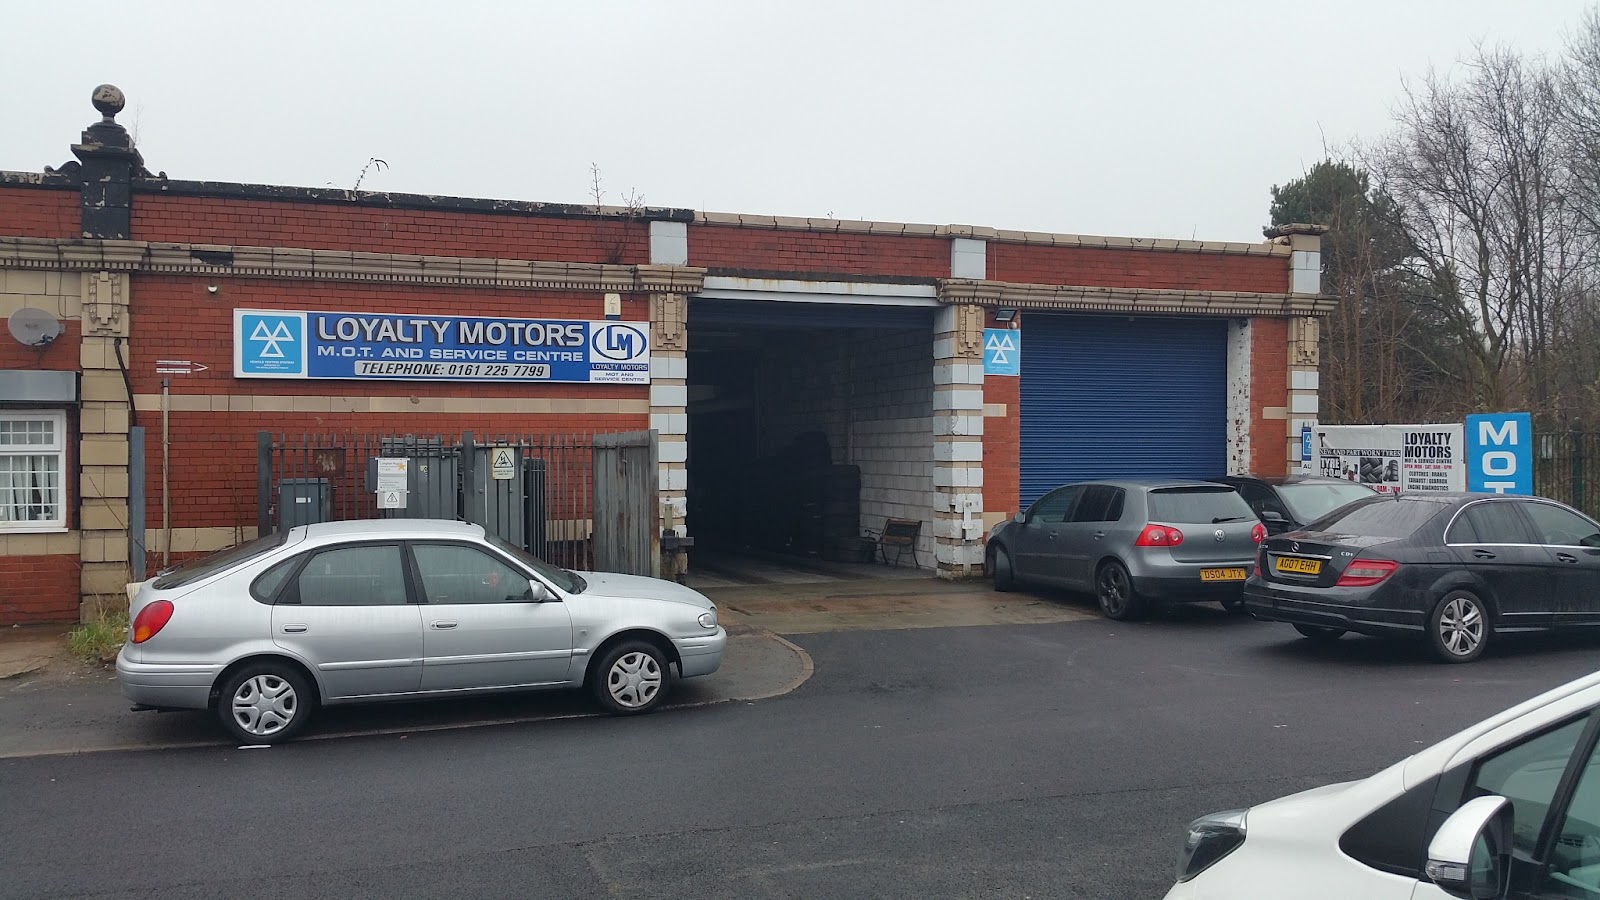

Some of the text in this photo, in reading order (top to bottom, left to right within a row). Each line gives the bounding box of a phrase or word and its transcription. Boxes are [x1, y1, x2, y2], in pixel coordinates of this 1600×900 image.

[317, 316, 584, 347] LOYALTY MOTORS
[606, 326, 632, 360] LM
[317, 346, 584, 362] M.O.T. AND SERVICE CENTRE
[361, 362, 545, 377] TELEPHONE: 0161 225 7799
[1404, 432, 1452, 445] LOYALTY
[1404, 446, 1452, 459] MOTORS
[1279, 558, 1316, 571] AG07 EHH
[1204, 569, 1243, 579] DS04 JTX
